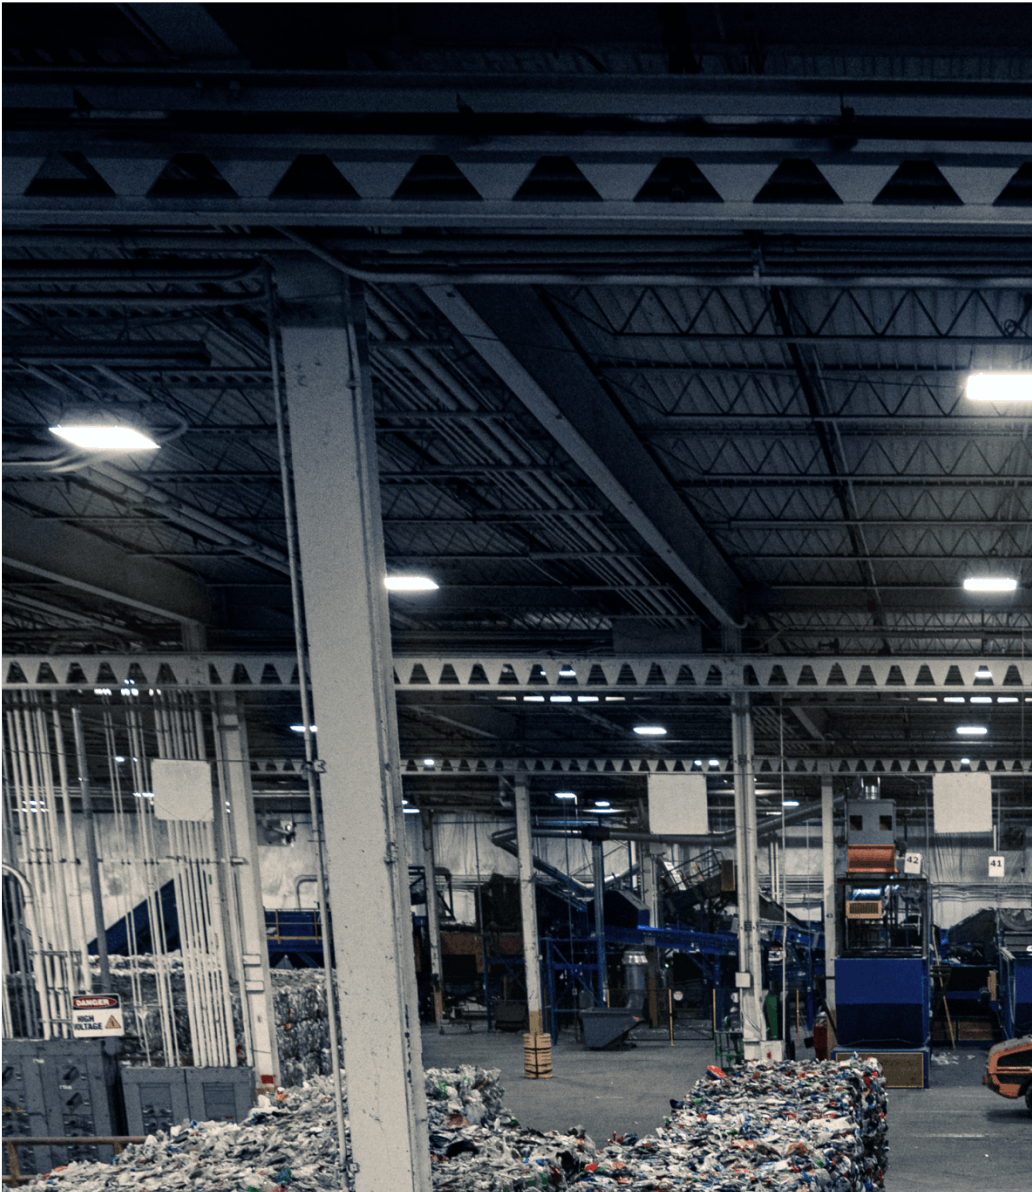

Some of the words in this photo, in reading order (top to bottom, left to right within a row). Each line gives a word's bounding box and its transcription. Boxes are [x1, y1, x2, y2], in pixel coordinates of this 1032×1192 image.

[906, 856, 919, 864] 42
[991, 859, 1002, 867] 41
[76, 998, 110, 1007] DANGER
